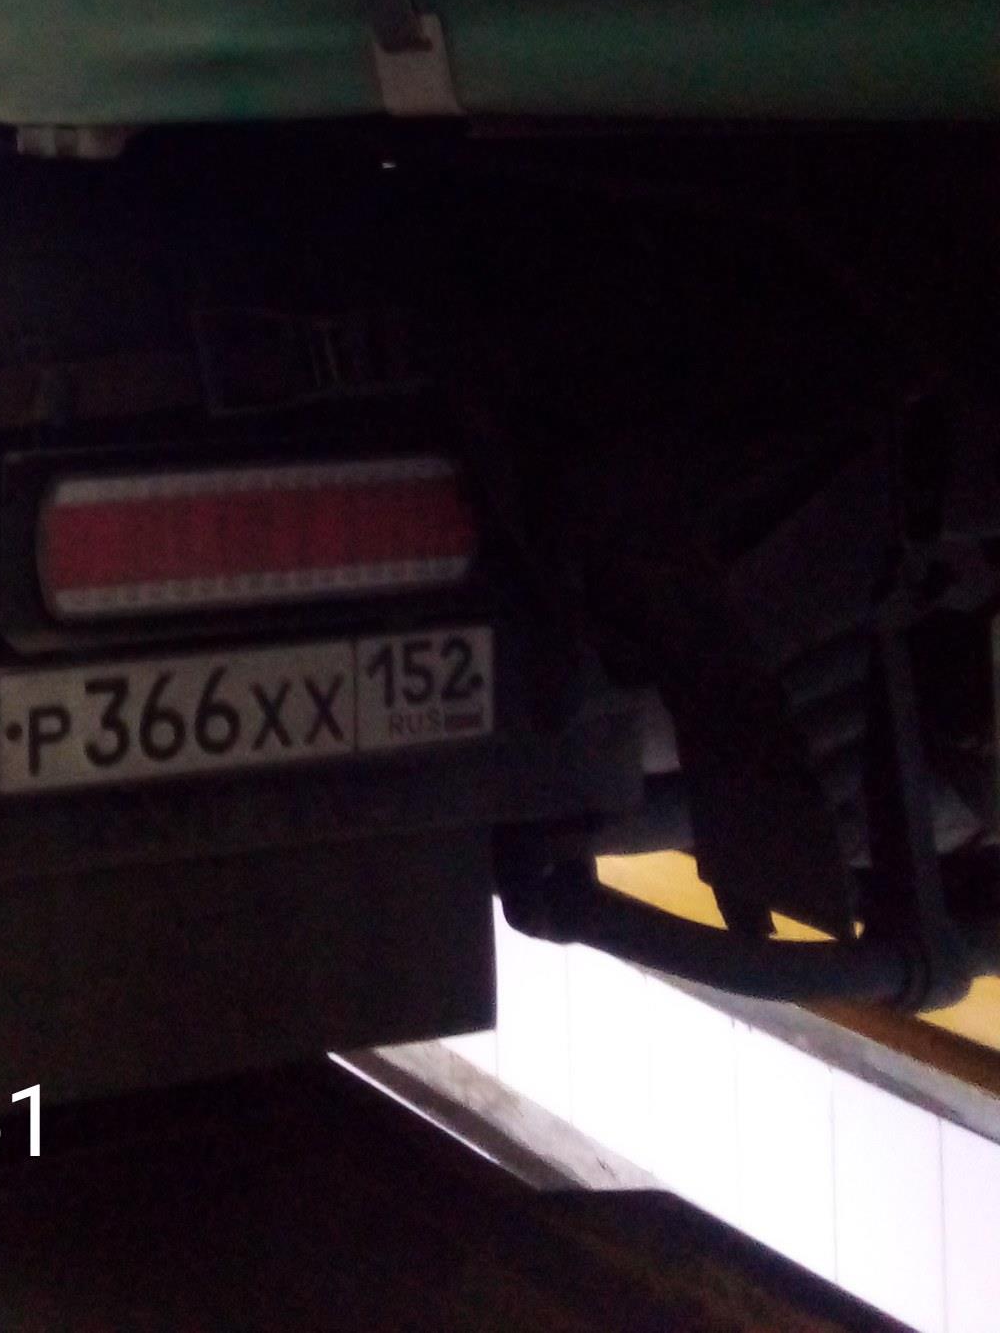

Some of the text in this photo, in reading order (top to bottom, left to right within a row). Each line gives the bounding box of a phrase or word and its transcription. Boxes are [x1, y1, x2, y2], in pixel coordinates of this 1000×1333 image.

[366, 637, 473, 708] 152
[27, 669, 344, 777] P366XX
[388, 707, 442, 739] RUS
